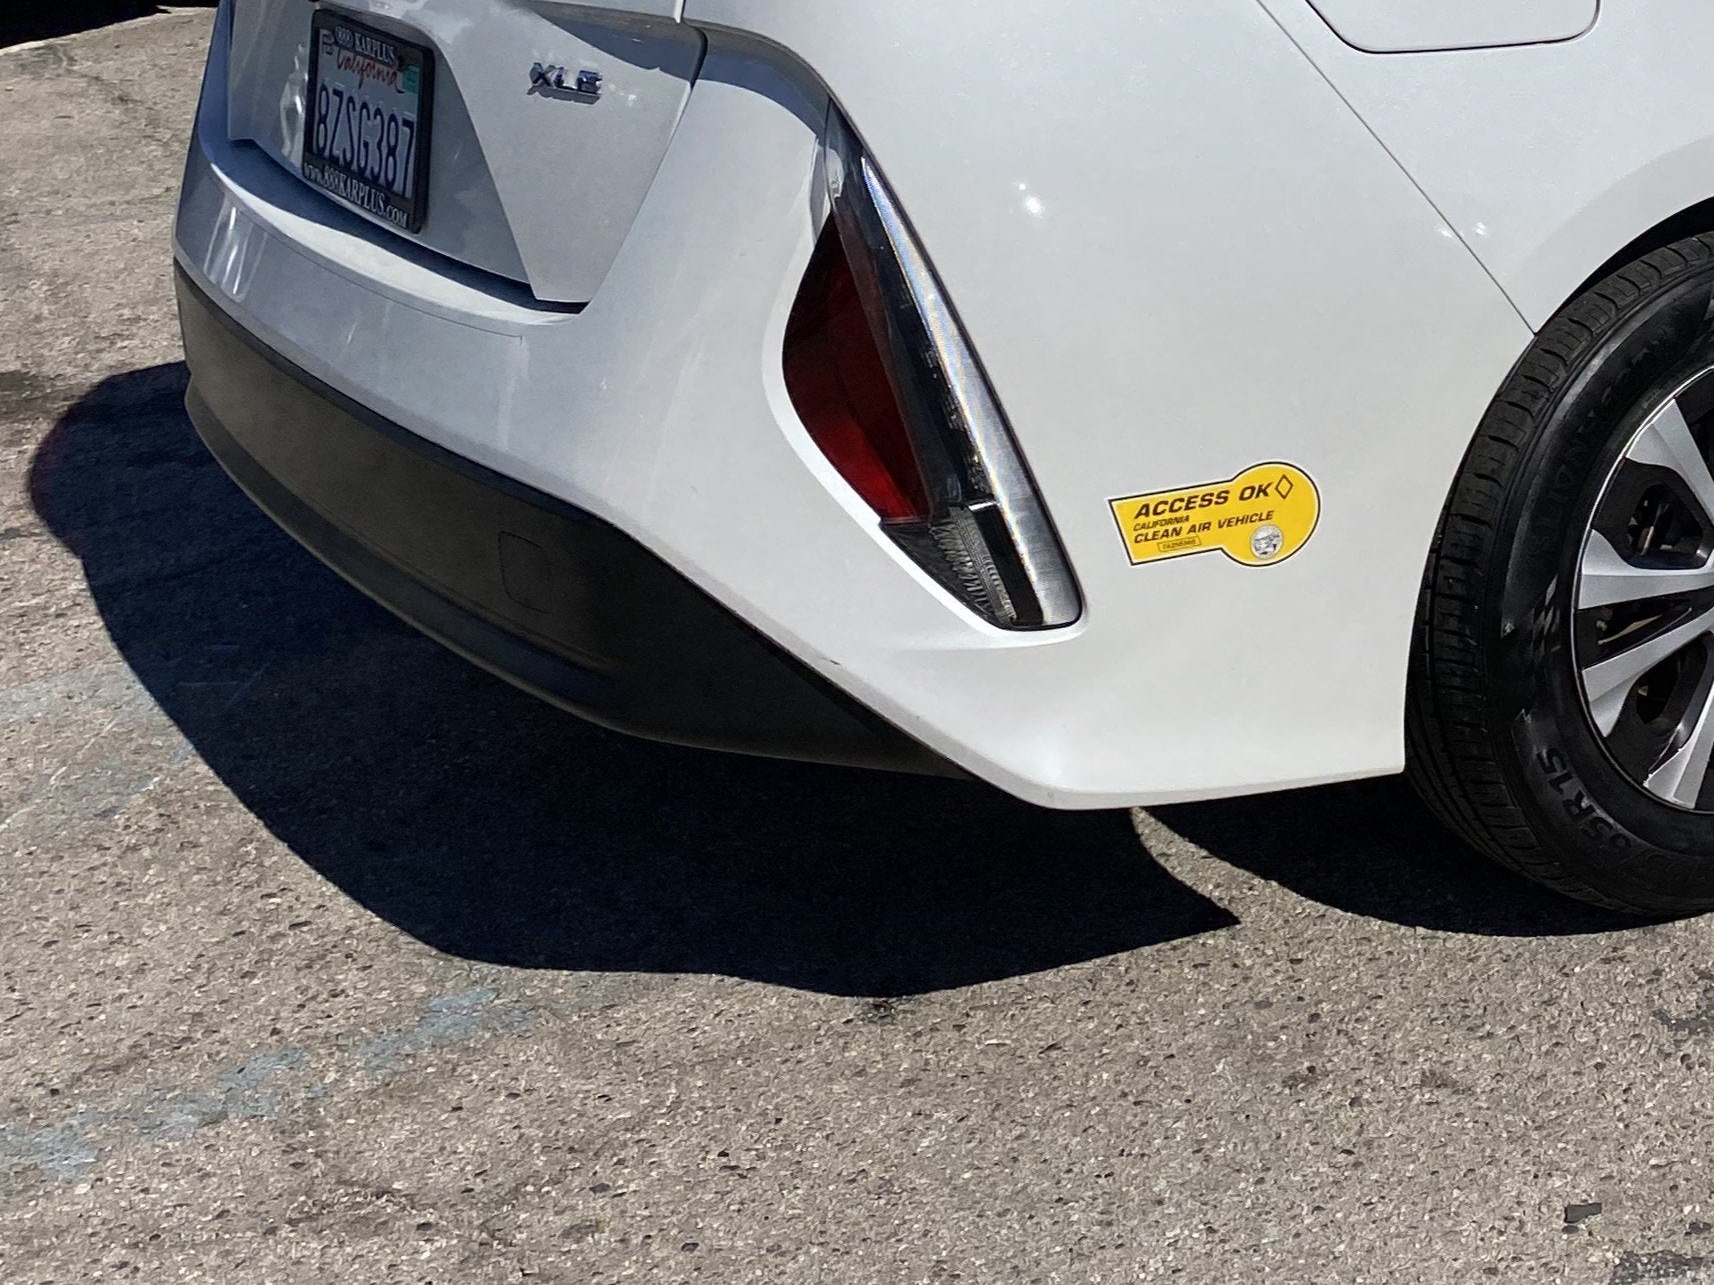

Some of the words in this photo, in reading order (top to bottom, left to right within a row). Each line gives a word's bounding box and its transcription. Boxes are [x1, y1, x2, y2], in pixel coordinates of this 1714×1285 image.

[354, 32, 396, 66] KARPLUS
[529, 61, 602, 96] XLE
[316, 82, 415, 197] 8ZSG387
[1134, 490, 1230, 519] ACCESS
[1238, 481, 1274, 502] OK
[1133, 514, 1190, 532] CALIFORNIA
[1134, 526, 1183, 544] CLEAN
[1187, 521, 1211, 535] AIR
[1218, 510, 1275, 529] VEHICLE
